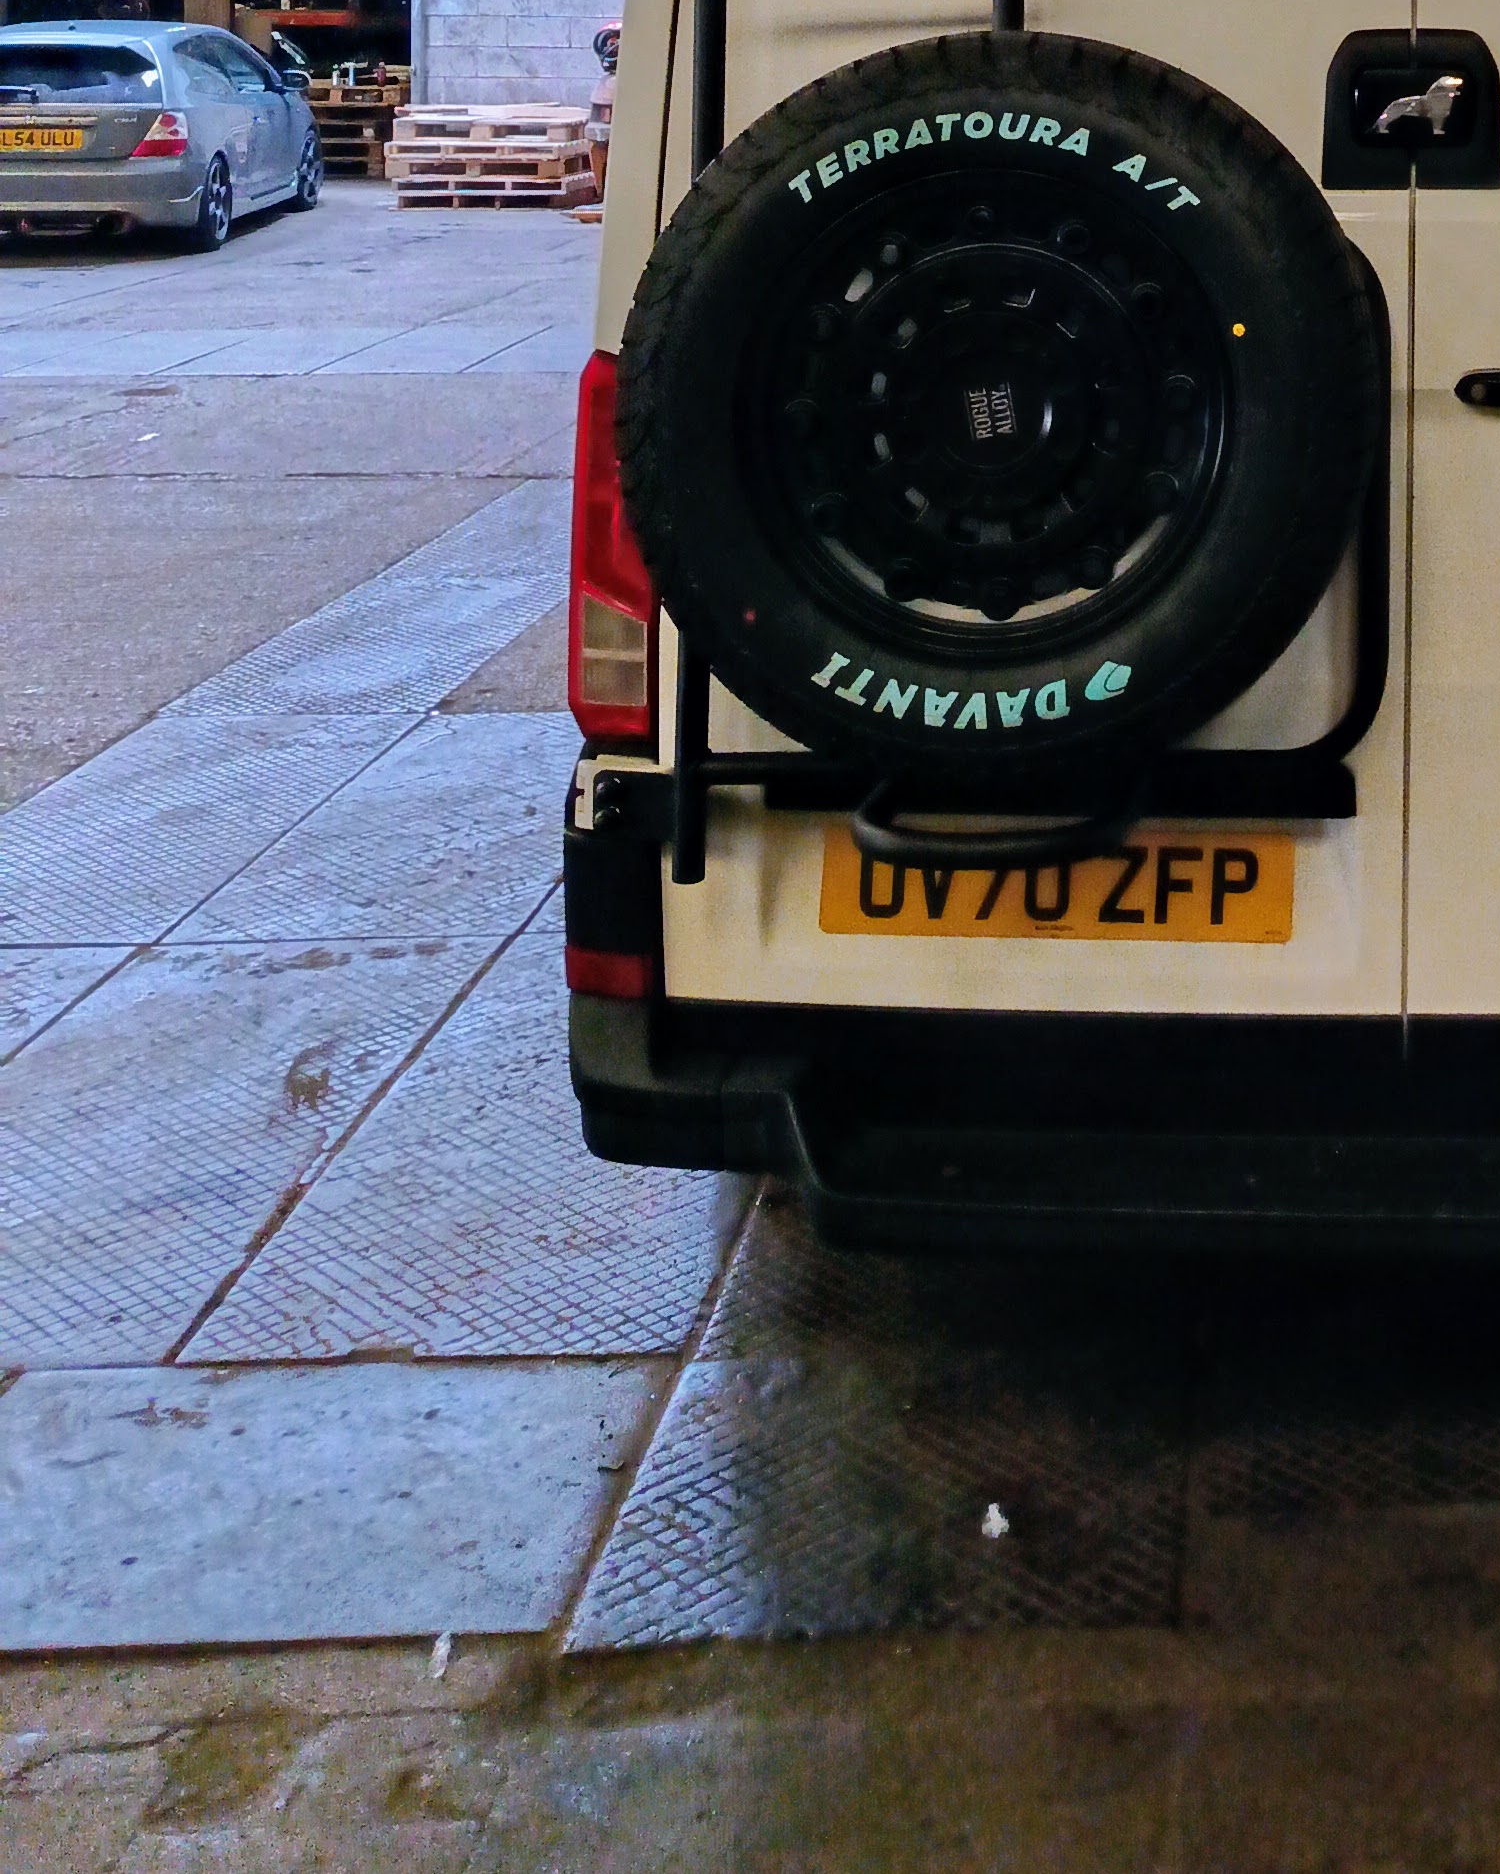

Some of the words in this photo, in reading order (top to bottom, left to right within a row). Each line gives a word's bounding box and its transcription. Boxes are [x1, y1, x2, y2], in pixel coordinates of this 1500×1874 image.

[0, 131, 35, 147] L54
[40, 131, 75, 146] ULU
[787, 110, 1091, 204] TERRATOURA
[1112, 153, 1201, 212] A/T
[968, 387, 993, 439] ROGUE
[991, 390, 1013, 434] ALLOY
[811, 652, 1071, 730] DAVANTI
[1097, 845, 1259, 925] ZFP
